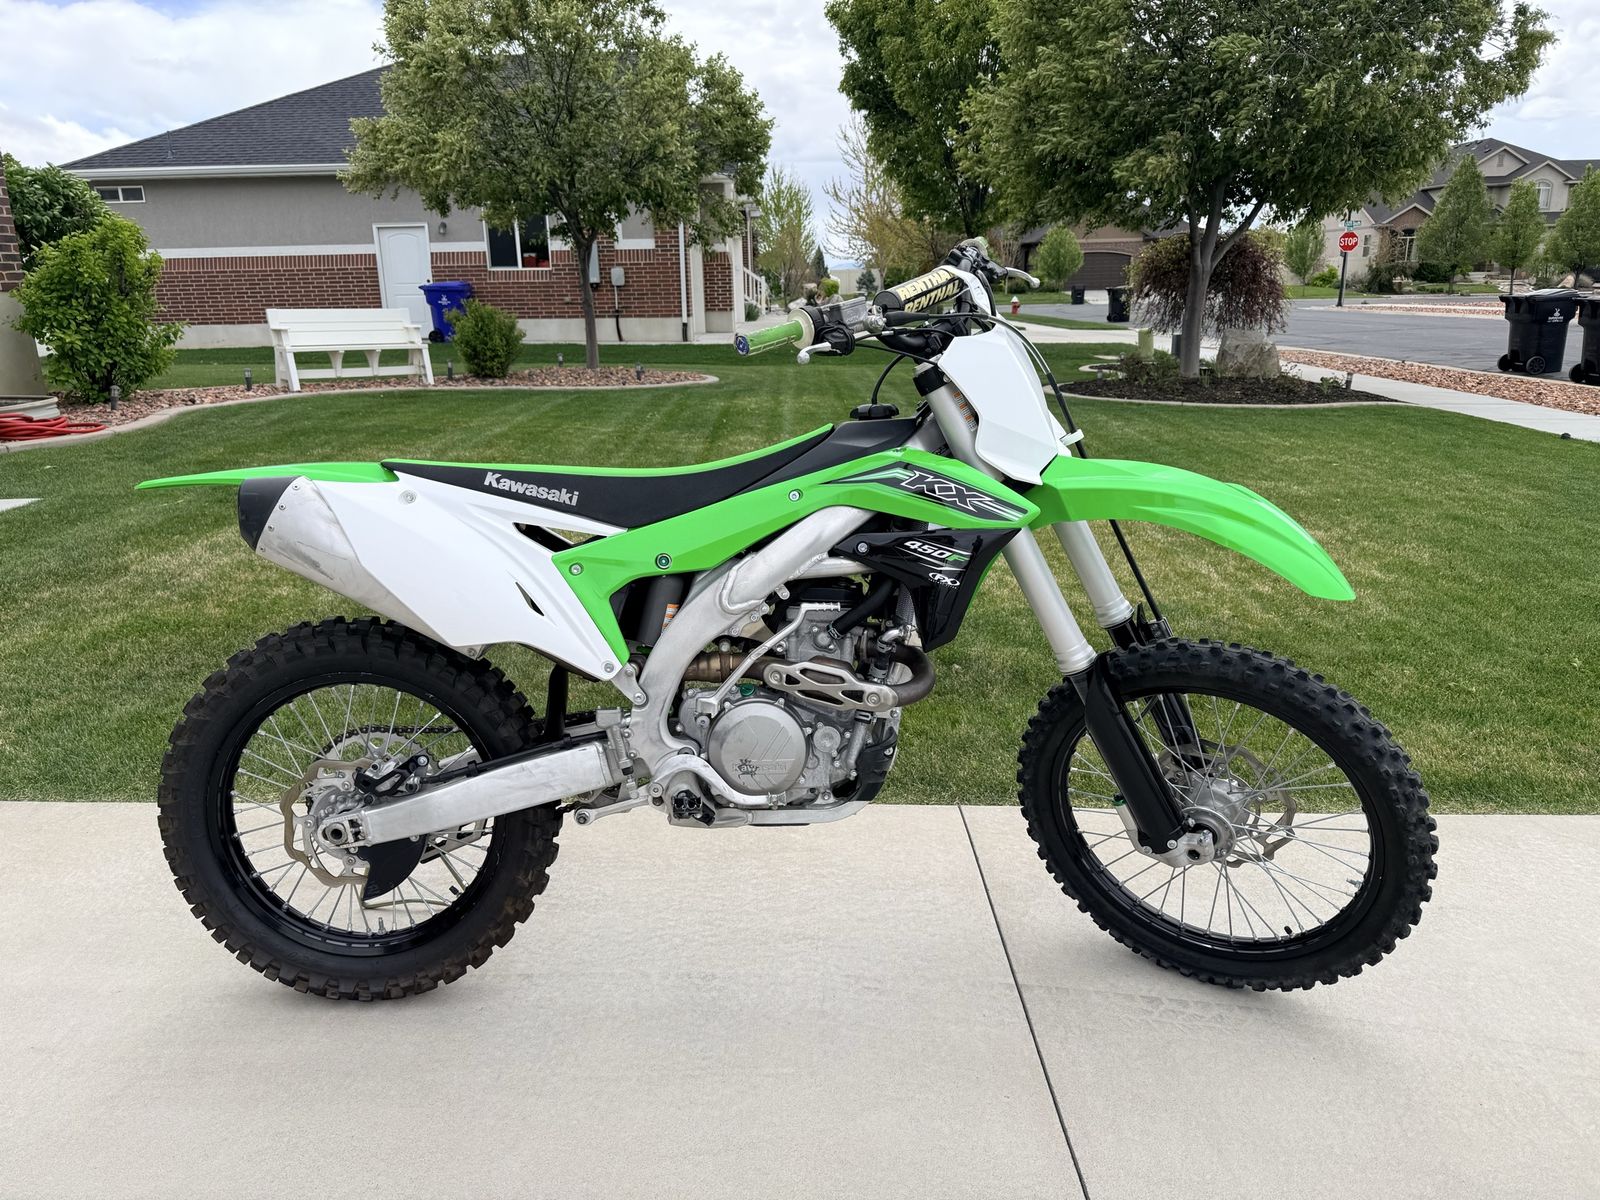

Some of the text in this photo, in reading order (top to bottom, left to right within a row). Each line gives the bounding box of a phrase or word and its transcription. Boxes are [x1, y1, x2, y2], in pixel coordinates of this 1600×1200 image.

[1340, 237, 1358, 246] STOP
[483, 471, 579, 506] Kawasaki
[900, 470, 994, 513] KX
[904, 541, 970, 562] 450F
